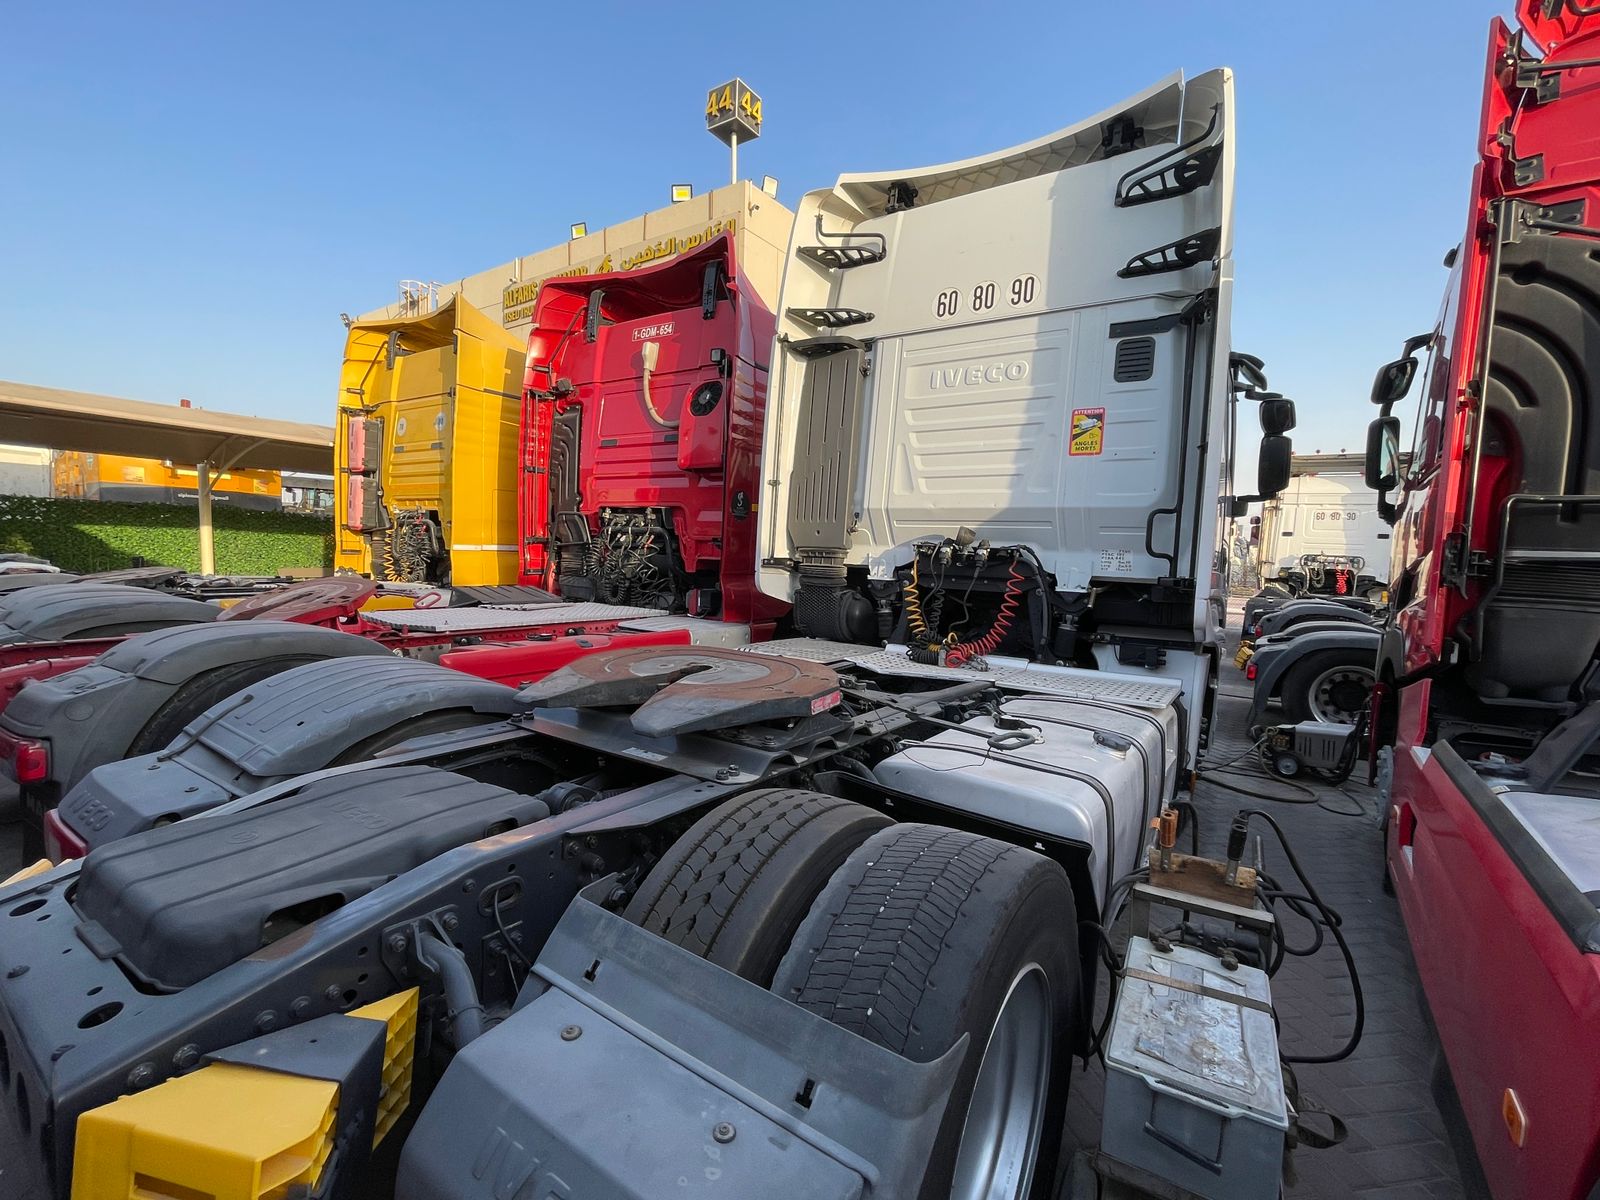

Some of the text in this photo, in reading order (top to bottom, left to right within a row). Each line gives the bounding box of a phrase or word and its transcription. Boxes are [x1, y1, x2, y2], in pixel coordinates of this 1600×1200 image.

[706, 86, 734, 117] 44
[741, 91, 763, 124] 44
[503, 281, 538, 308] ALFARIS
[937, 276, 1034, 318] 60 80 90
[634, 323, 673, 340] 1-GDM-654
[929, 360, 1030, 390] IVECO
[1316, 512, 1325, 520] 60
[1346, 512, 1356, 520] 90
